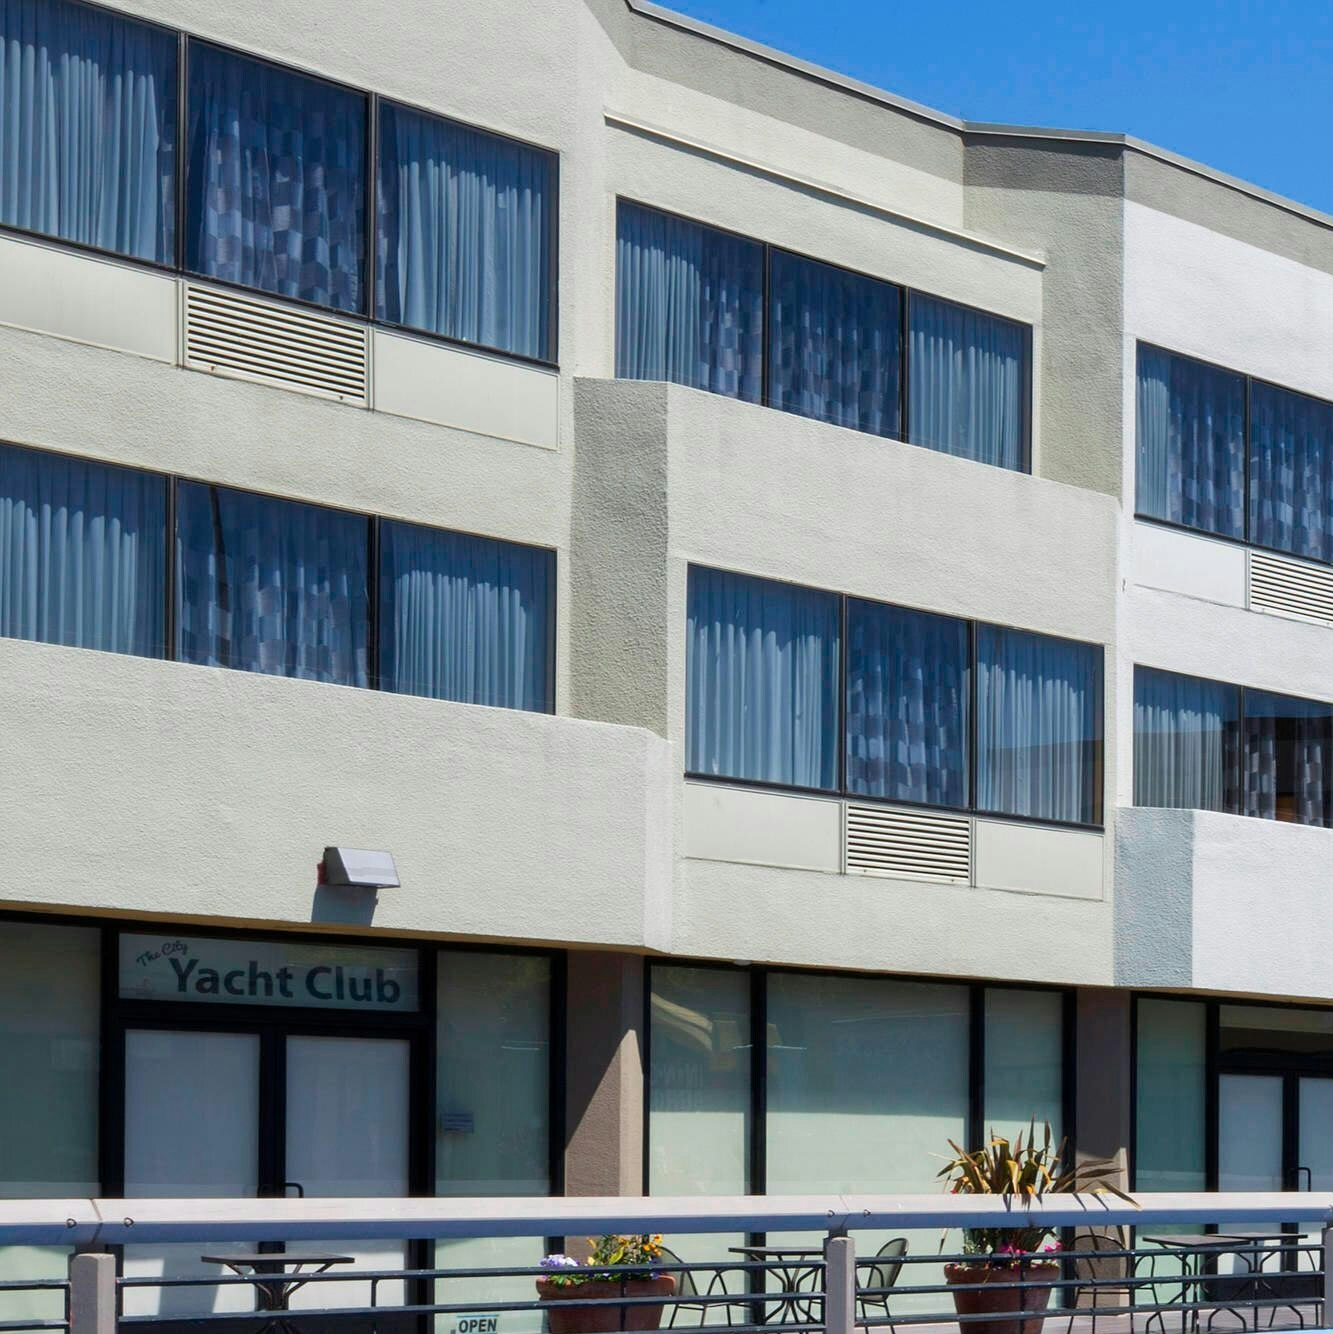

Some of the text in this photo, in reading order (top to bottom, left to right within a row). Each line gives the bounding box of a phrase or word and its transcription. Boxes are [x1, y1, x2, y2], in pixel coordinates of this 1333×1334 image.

[136, 940, 189, 967] The City
[168, 957, 401, 1003] Yacht Club
[458, 1318, 498, 1334] OPEN
